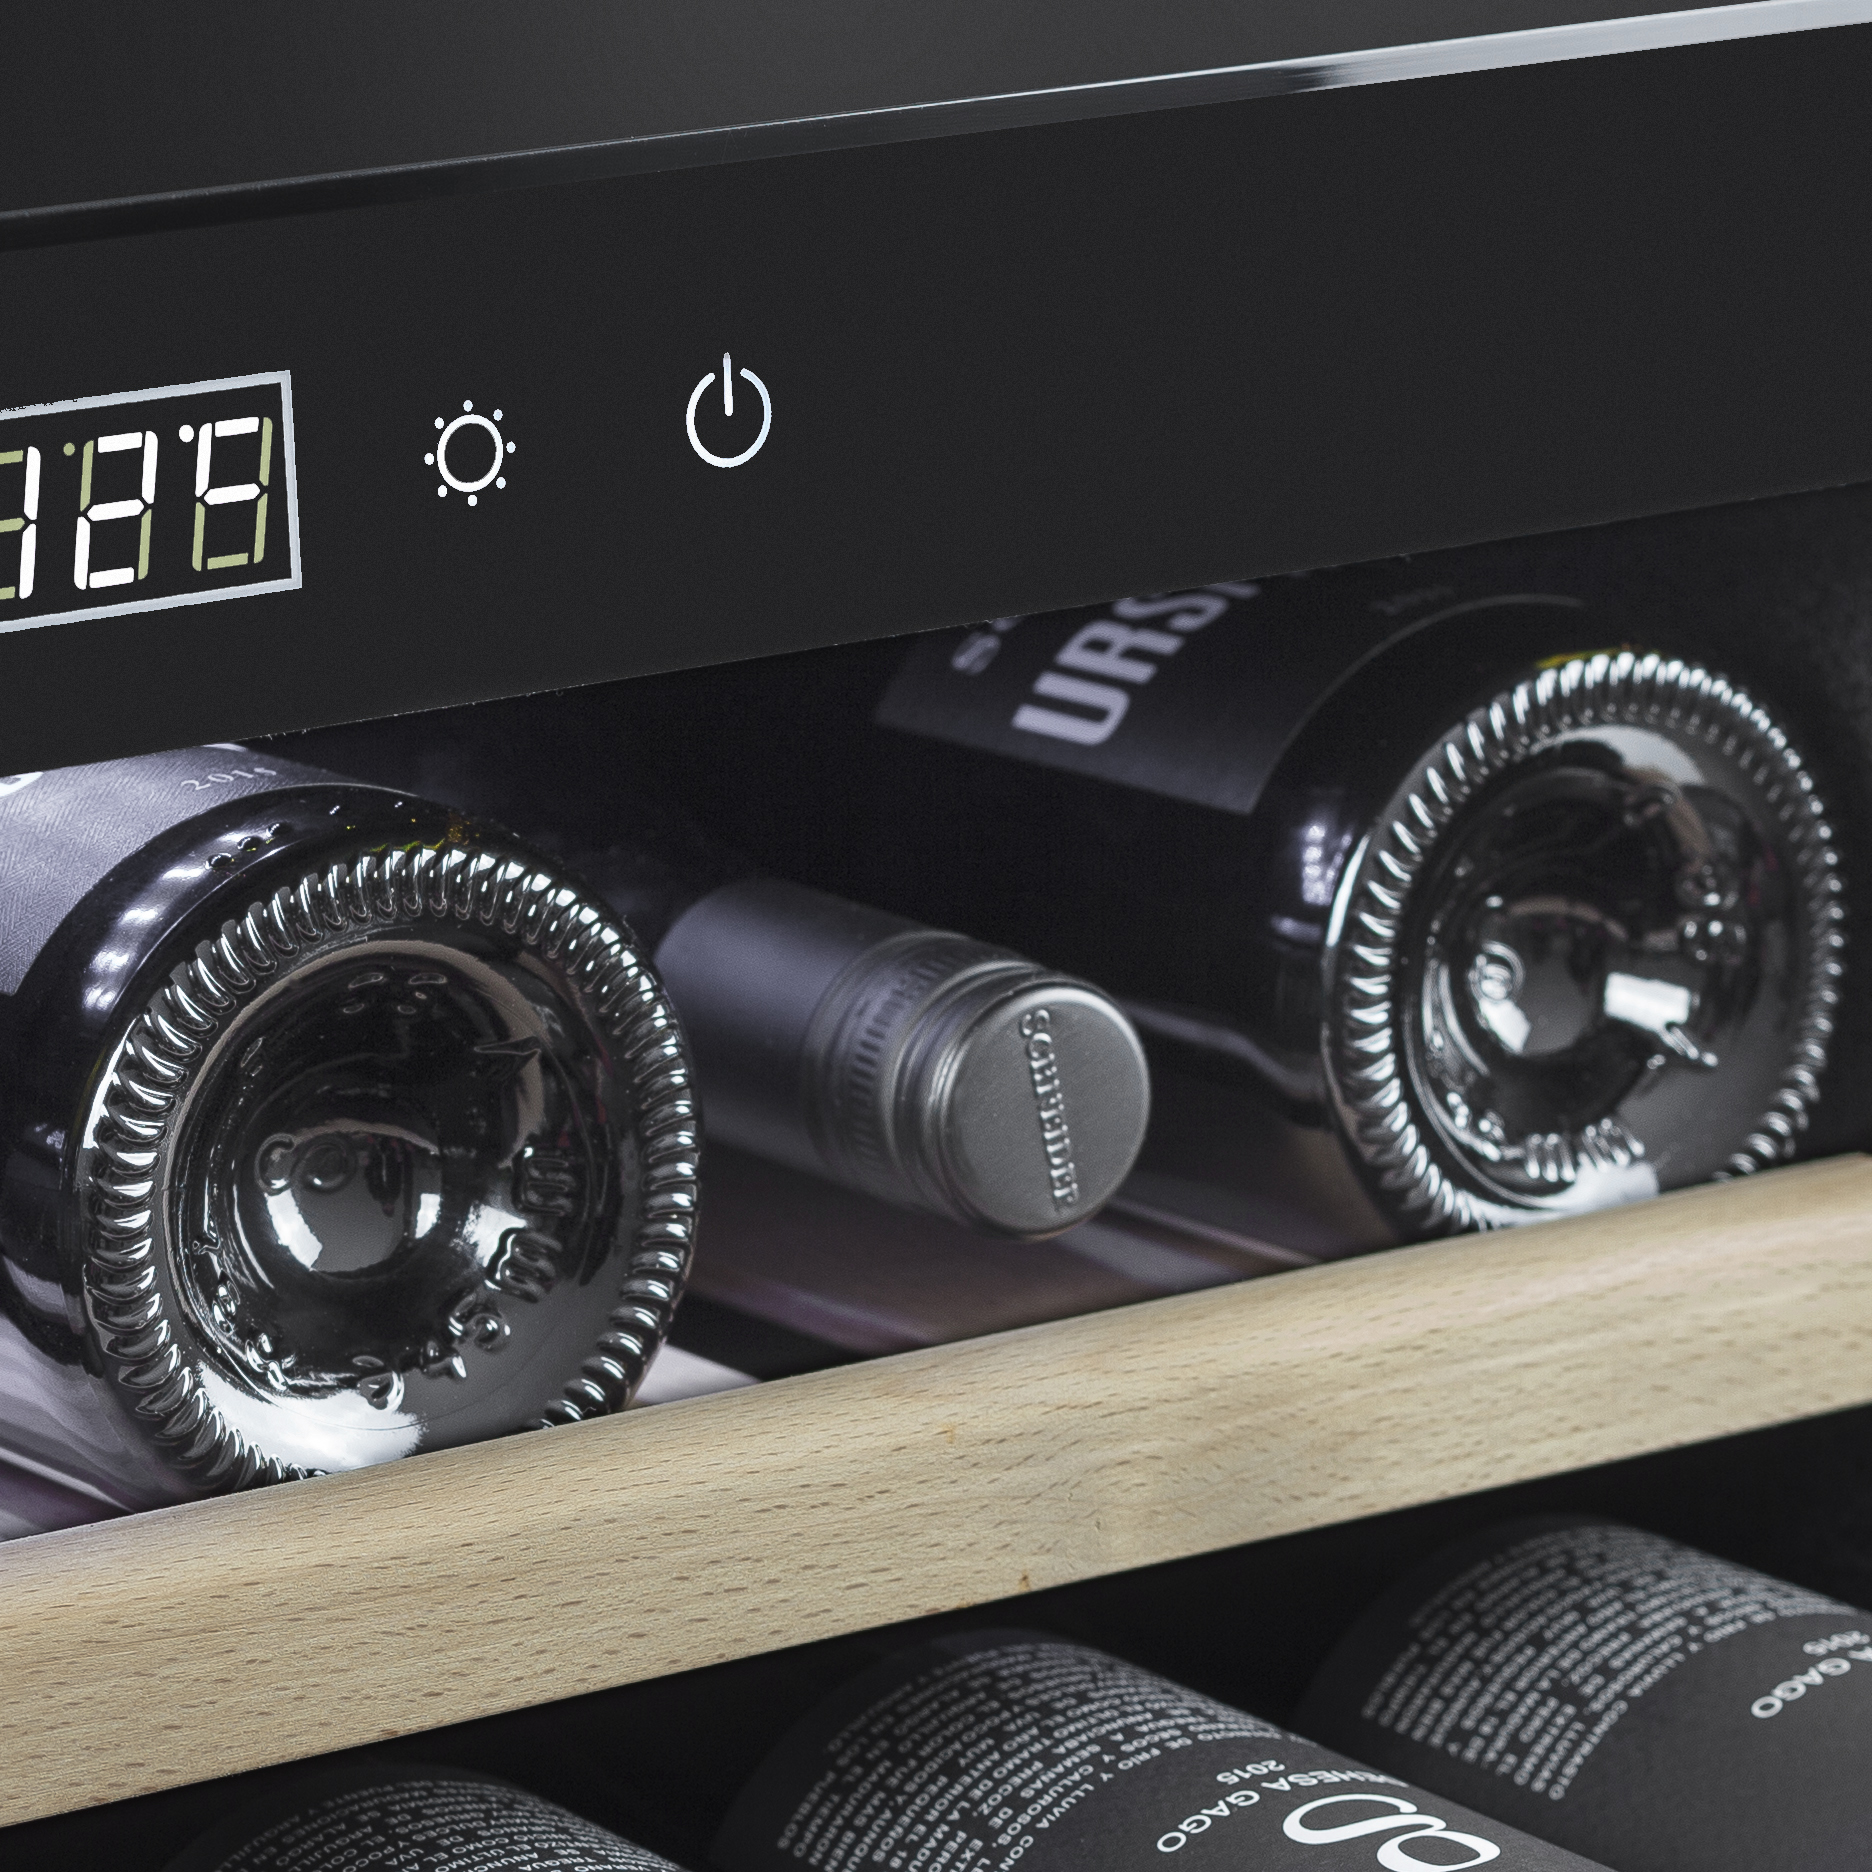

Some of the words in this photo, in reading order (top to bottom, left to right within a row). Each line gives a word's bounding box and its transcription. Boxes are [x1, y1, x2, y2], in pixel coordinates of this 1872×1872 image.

[1750, 1658, 1852, 1719] GAGO
[1216, 1760, 1286, 1786] 2015
[1156, 1790, 1261, 1853] GAGO
